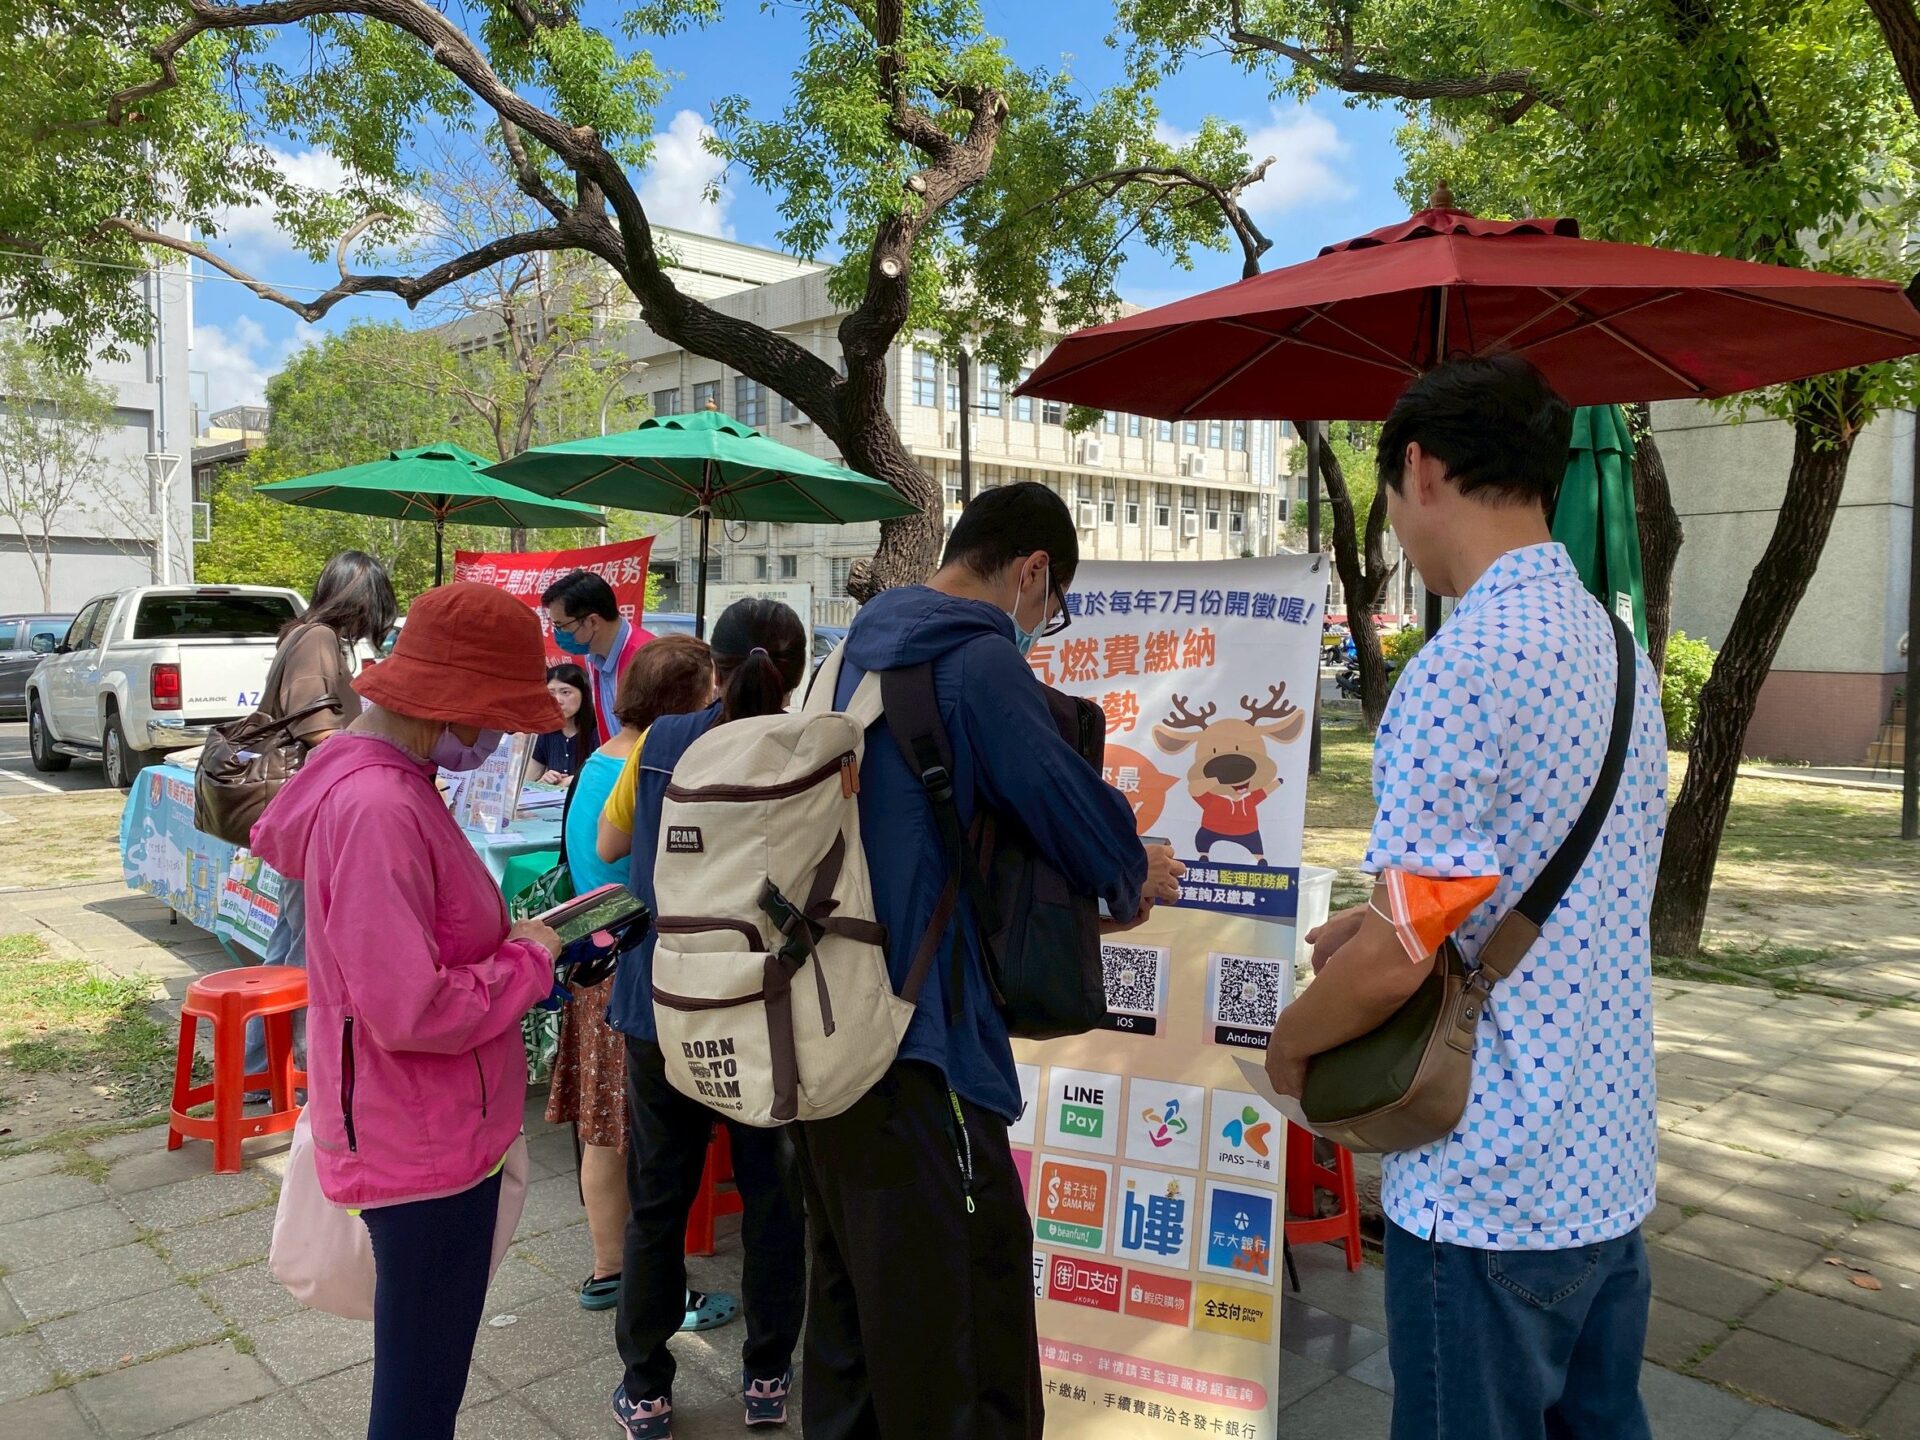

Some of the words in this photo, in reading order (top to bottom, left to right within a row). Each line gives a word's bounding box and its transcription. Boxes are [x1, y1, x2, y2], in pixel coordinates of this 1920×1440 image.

[1056, 588, 1316, 625] 費於每年7月份開徵喔!
[187, 696, 228, 704] AMAROK
[1116, 1016, 1135, 1029] iOS
[681, 1037, 736, 1059] BORN
[1226, 1031, 1268, 1047] Android
[708, 1058, 737, 1079] TO
[1063, 1084, 1104, 1106] LINE
[1065, 1110, 1098, 1133] Pay
[1219, 1152, 1245, 1165] iPASS
[1063, 1180, 1098, 1201] 橘子支付
[1061, 1197, 1083, 1210] GAMA
[1083, 1201, 1096, 1212] PAY
[1057, 1225, 1090, 1243] beanfun!
[1212, 1231, 1267, 1254] 元大銀行
[1055, 1262, 1118, 1294] 街口支付
[1204, 1299, 1242, 1321] 全支付
